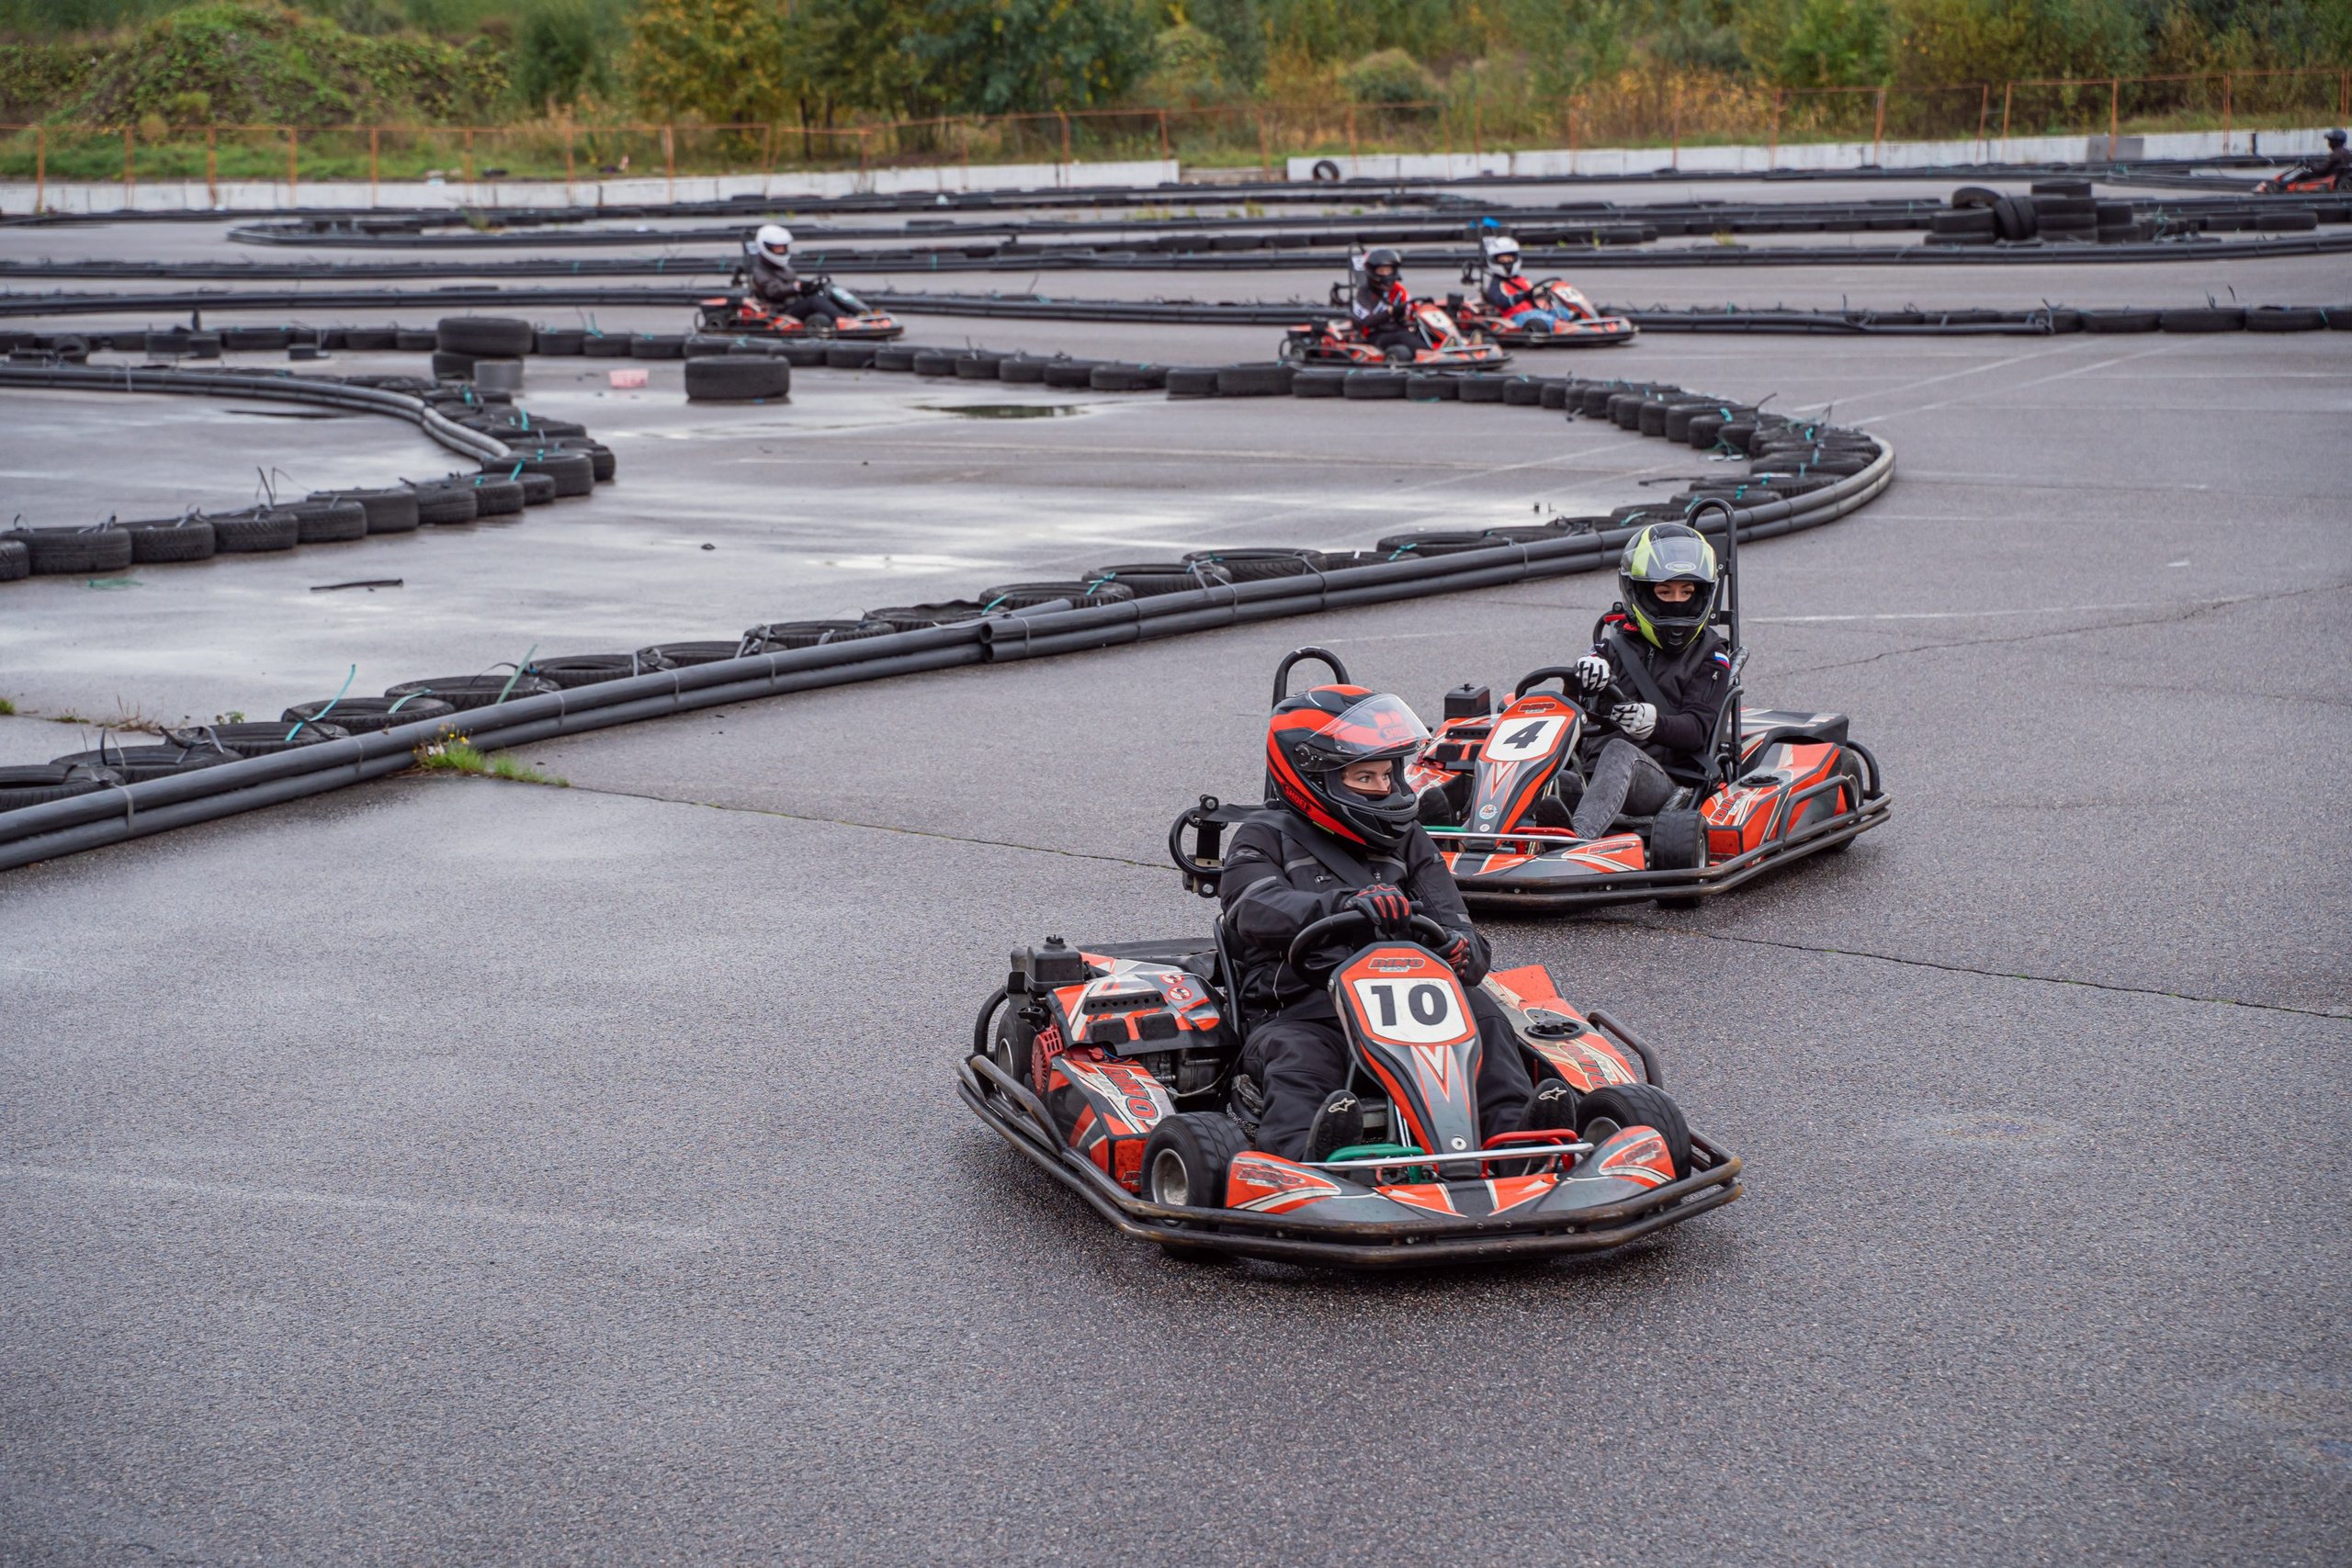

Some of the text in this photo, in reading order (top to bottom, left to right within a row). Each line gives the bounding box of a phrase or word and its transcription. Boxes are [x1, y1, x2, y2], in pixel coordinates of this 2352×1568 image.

[1502, 720, 1550, 749] 4
[1284, 784, 1307, 810] SHOEI
[1369, 958, 1425, 968] DINO
[1370, 984, 1448, 1027] 10
[1096, 1066, 1159, 1120] DINO
